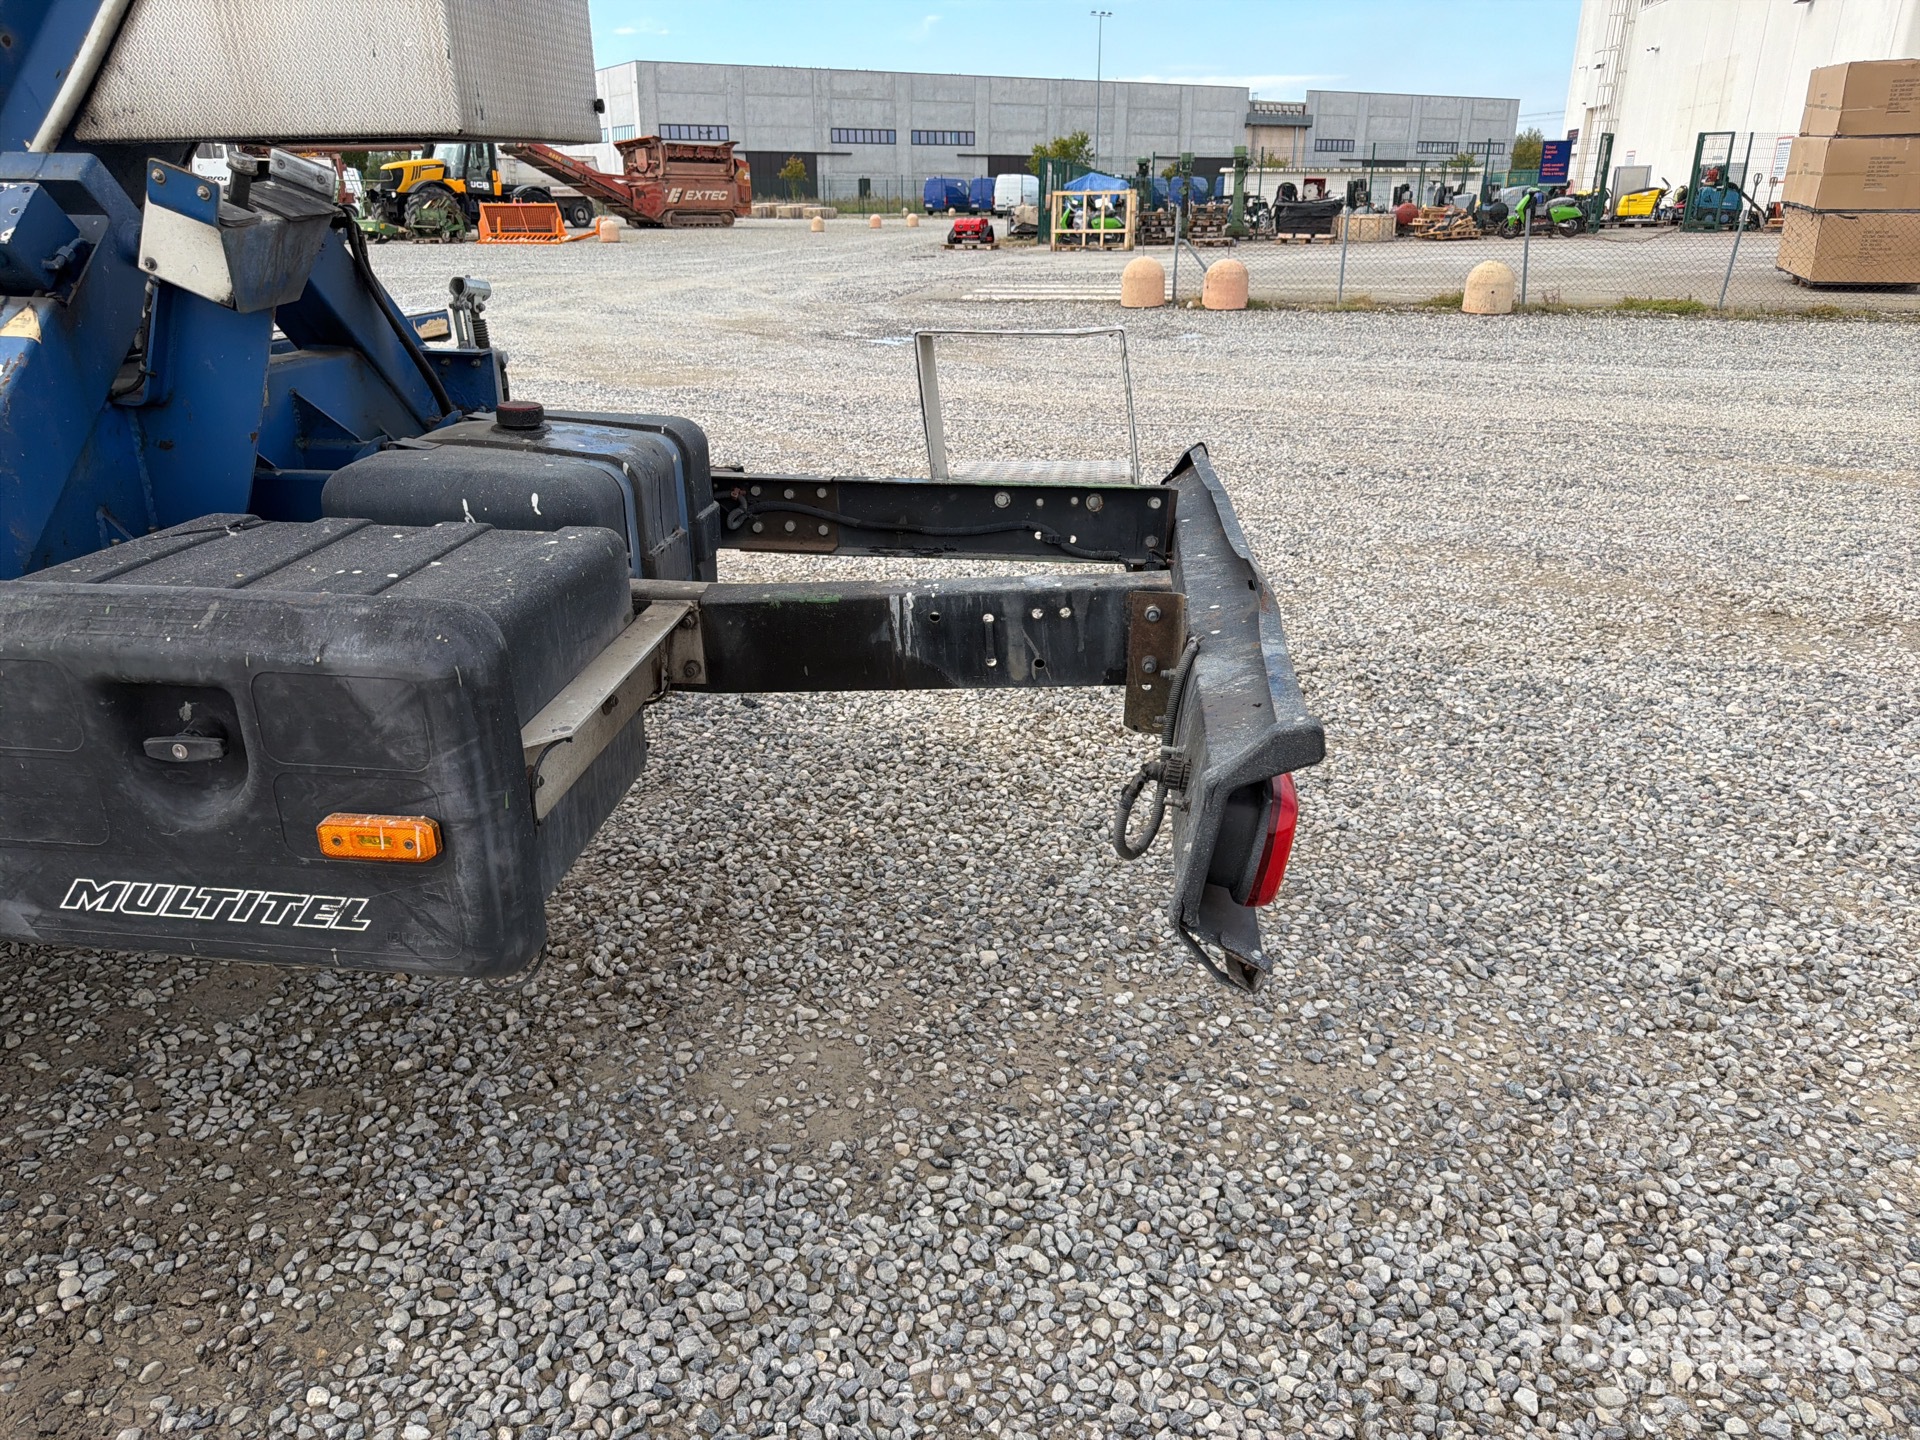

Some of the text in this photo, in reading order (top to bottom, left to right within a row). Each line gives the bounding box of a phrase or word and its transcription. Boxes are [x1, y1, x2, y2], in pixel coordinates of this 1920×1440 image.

[470, 180, 490, 191] JCB
[684, 190, 729, 201] EXTEC
[60, 878, 372, 931] MULTITEL
